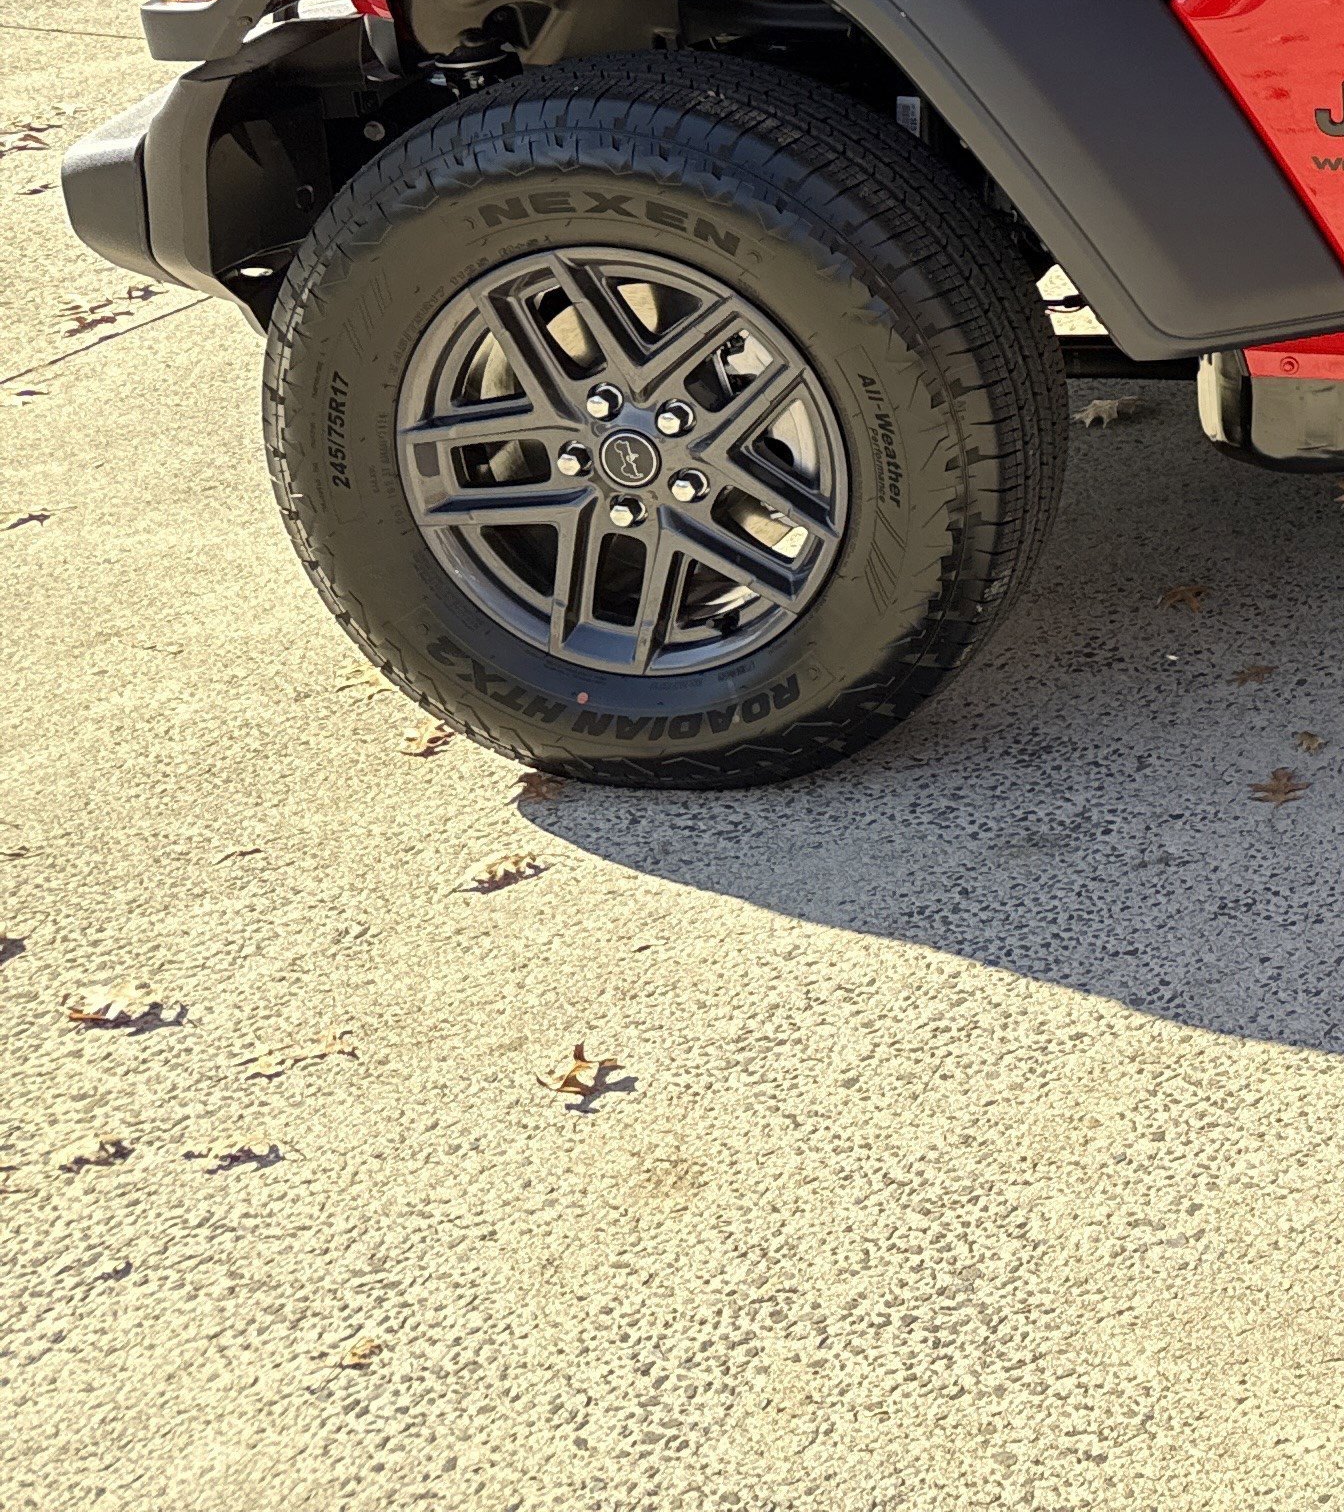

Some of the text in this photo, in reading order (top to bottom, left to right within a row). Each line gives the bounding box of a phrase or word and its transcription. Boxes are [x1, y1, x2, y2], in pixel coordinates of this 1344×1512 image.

[478, 191, 740, 257] NEXEN
[327, 370, 350, 490] 245/75R17
[857, 373, 903, 509] All-Weather
[427, 636, 801, 741] ROADIAN HTX2
